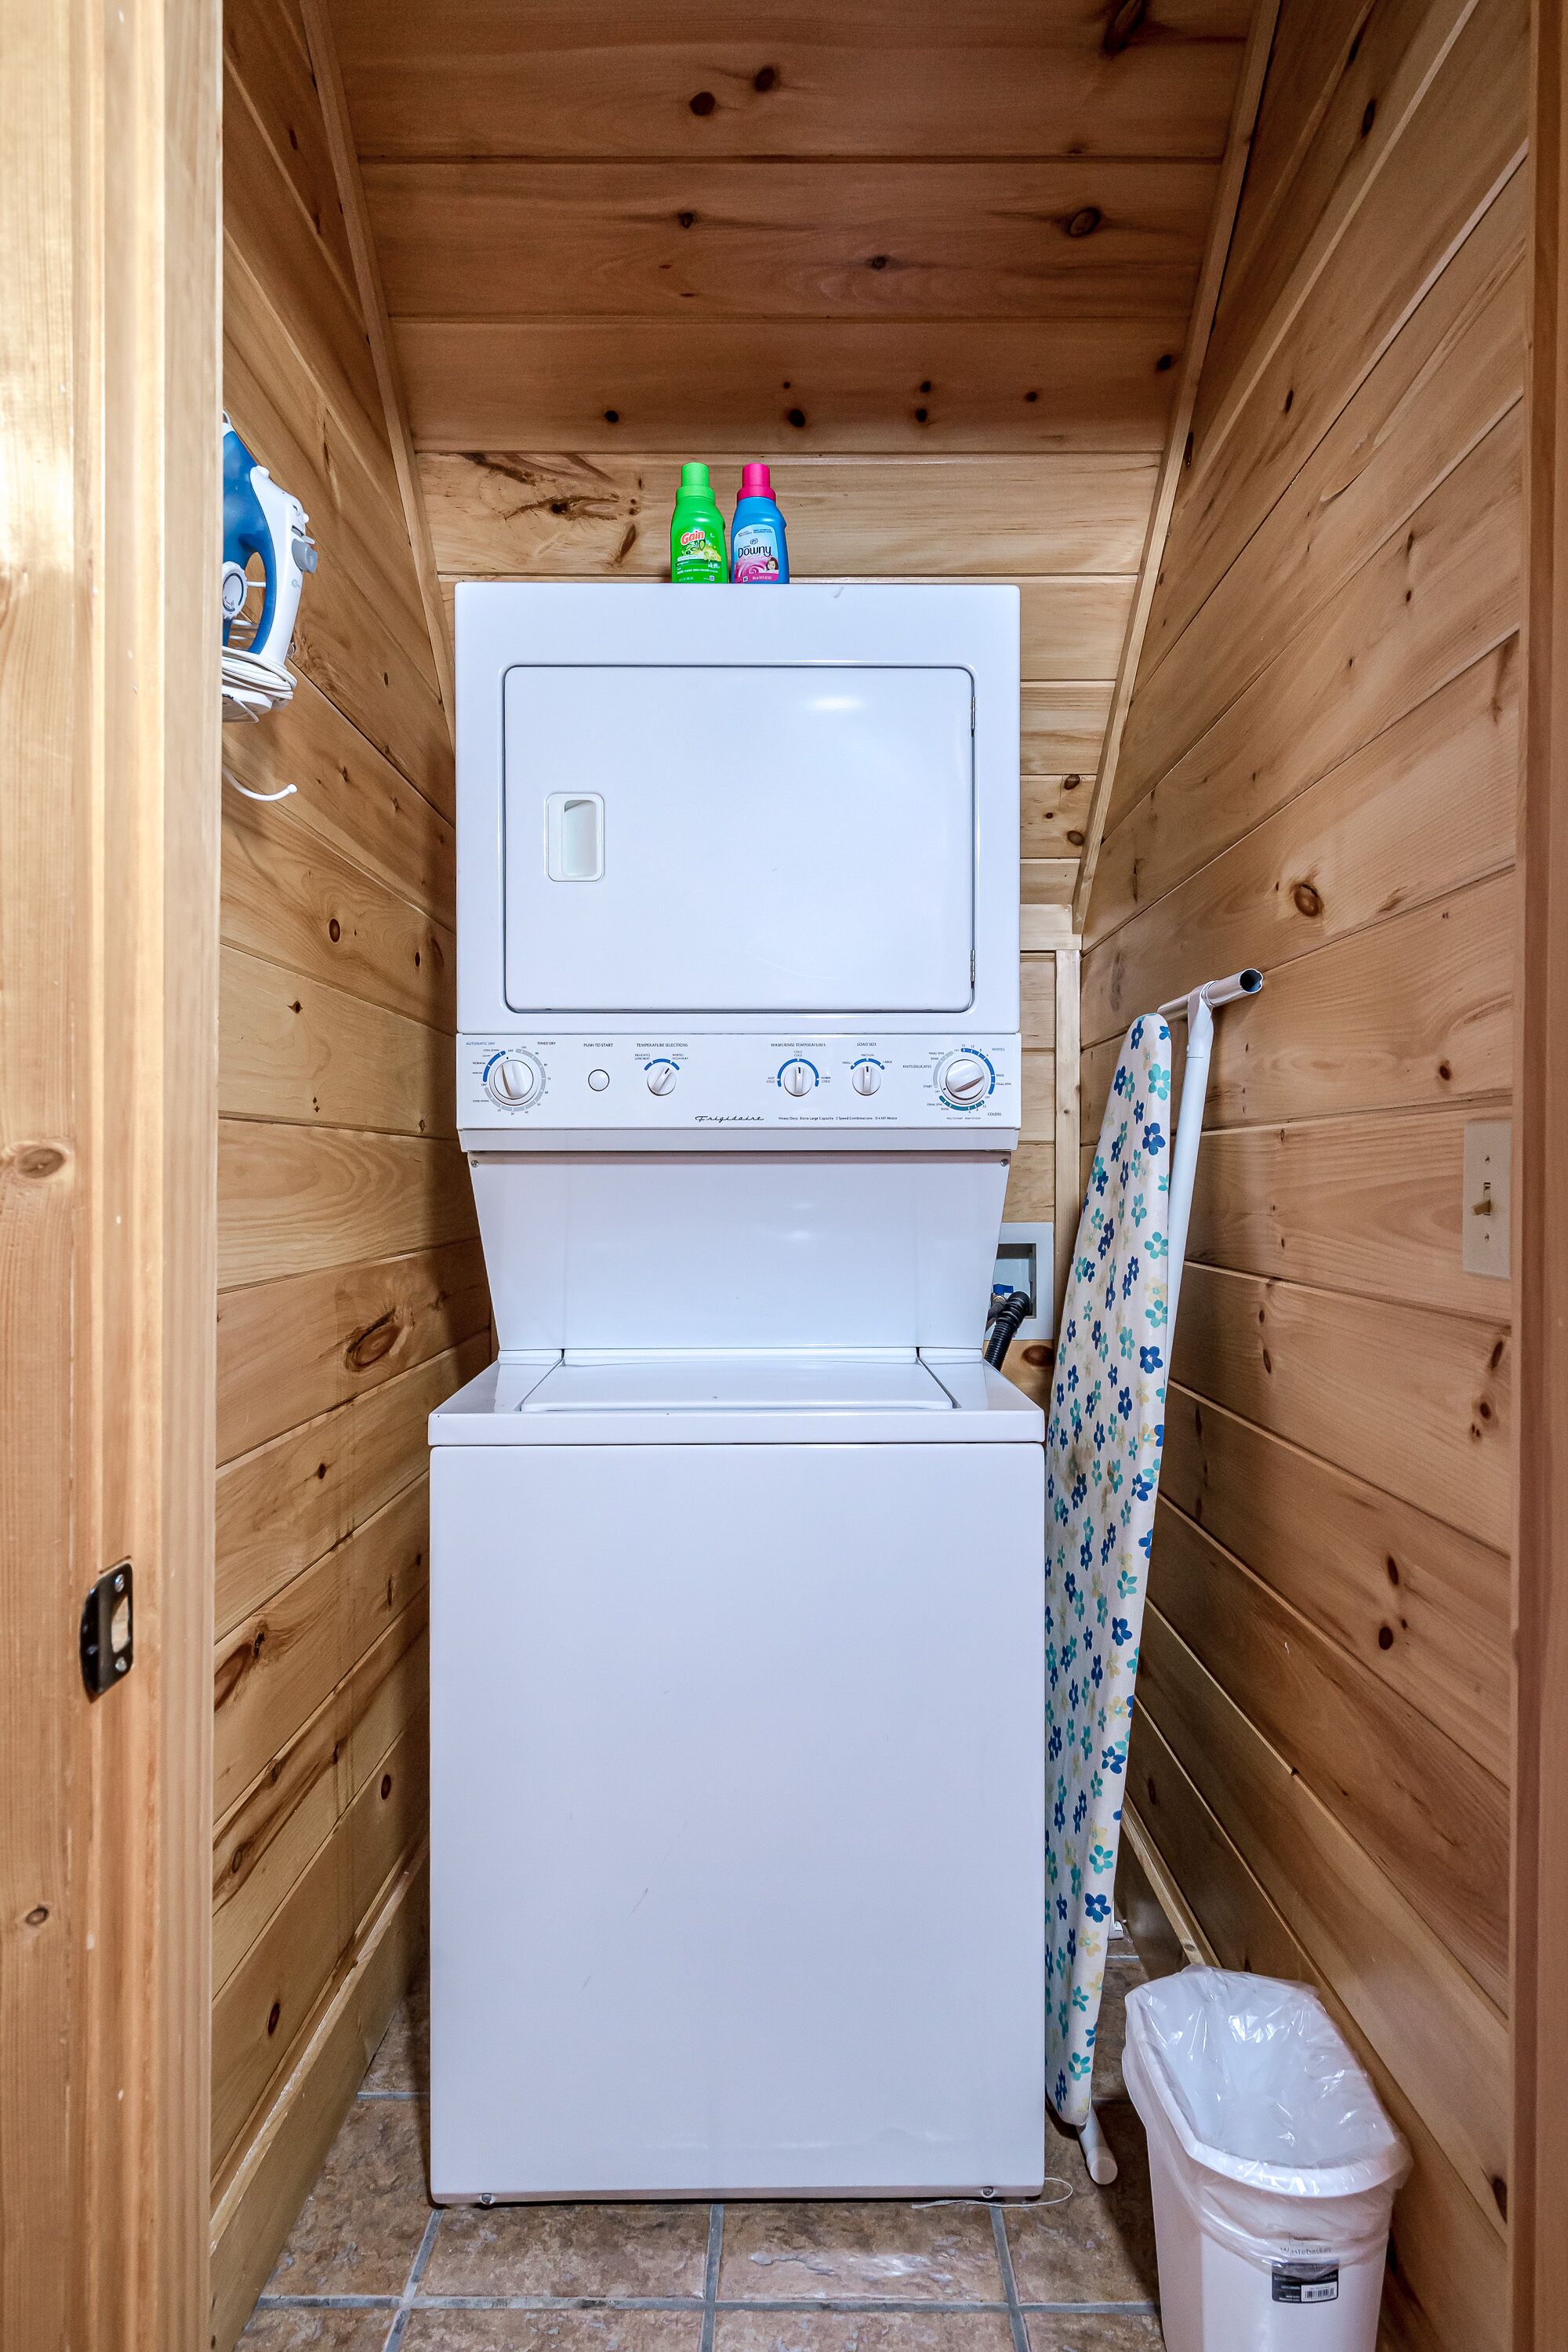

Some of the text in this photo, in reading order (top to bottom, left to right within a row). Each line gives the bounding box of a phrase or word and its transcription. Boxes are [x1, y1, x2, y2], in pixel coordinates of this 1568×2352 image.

[681, 530, 705, 546] Gain
[738, 546, 771, 558] Downy
[695, 1115, 764, 1123] Frigidaire
